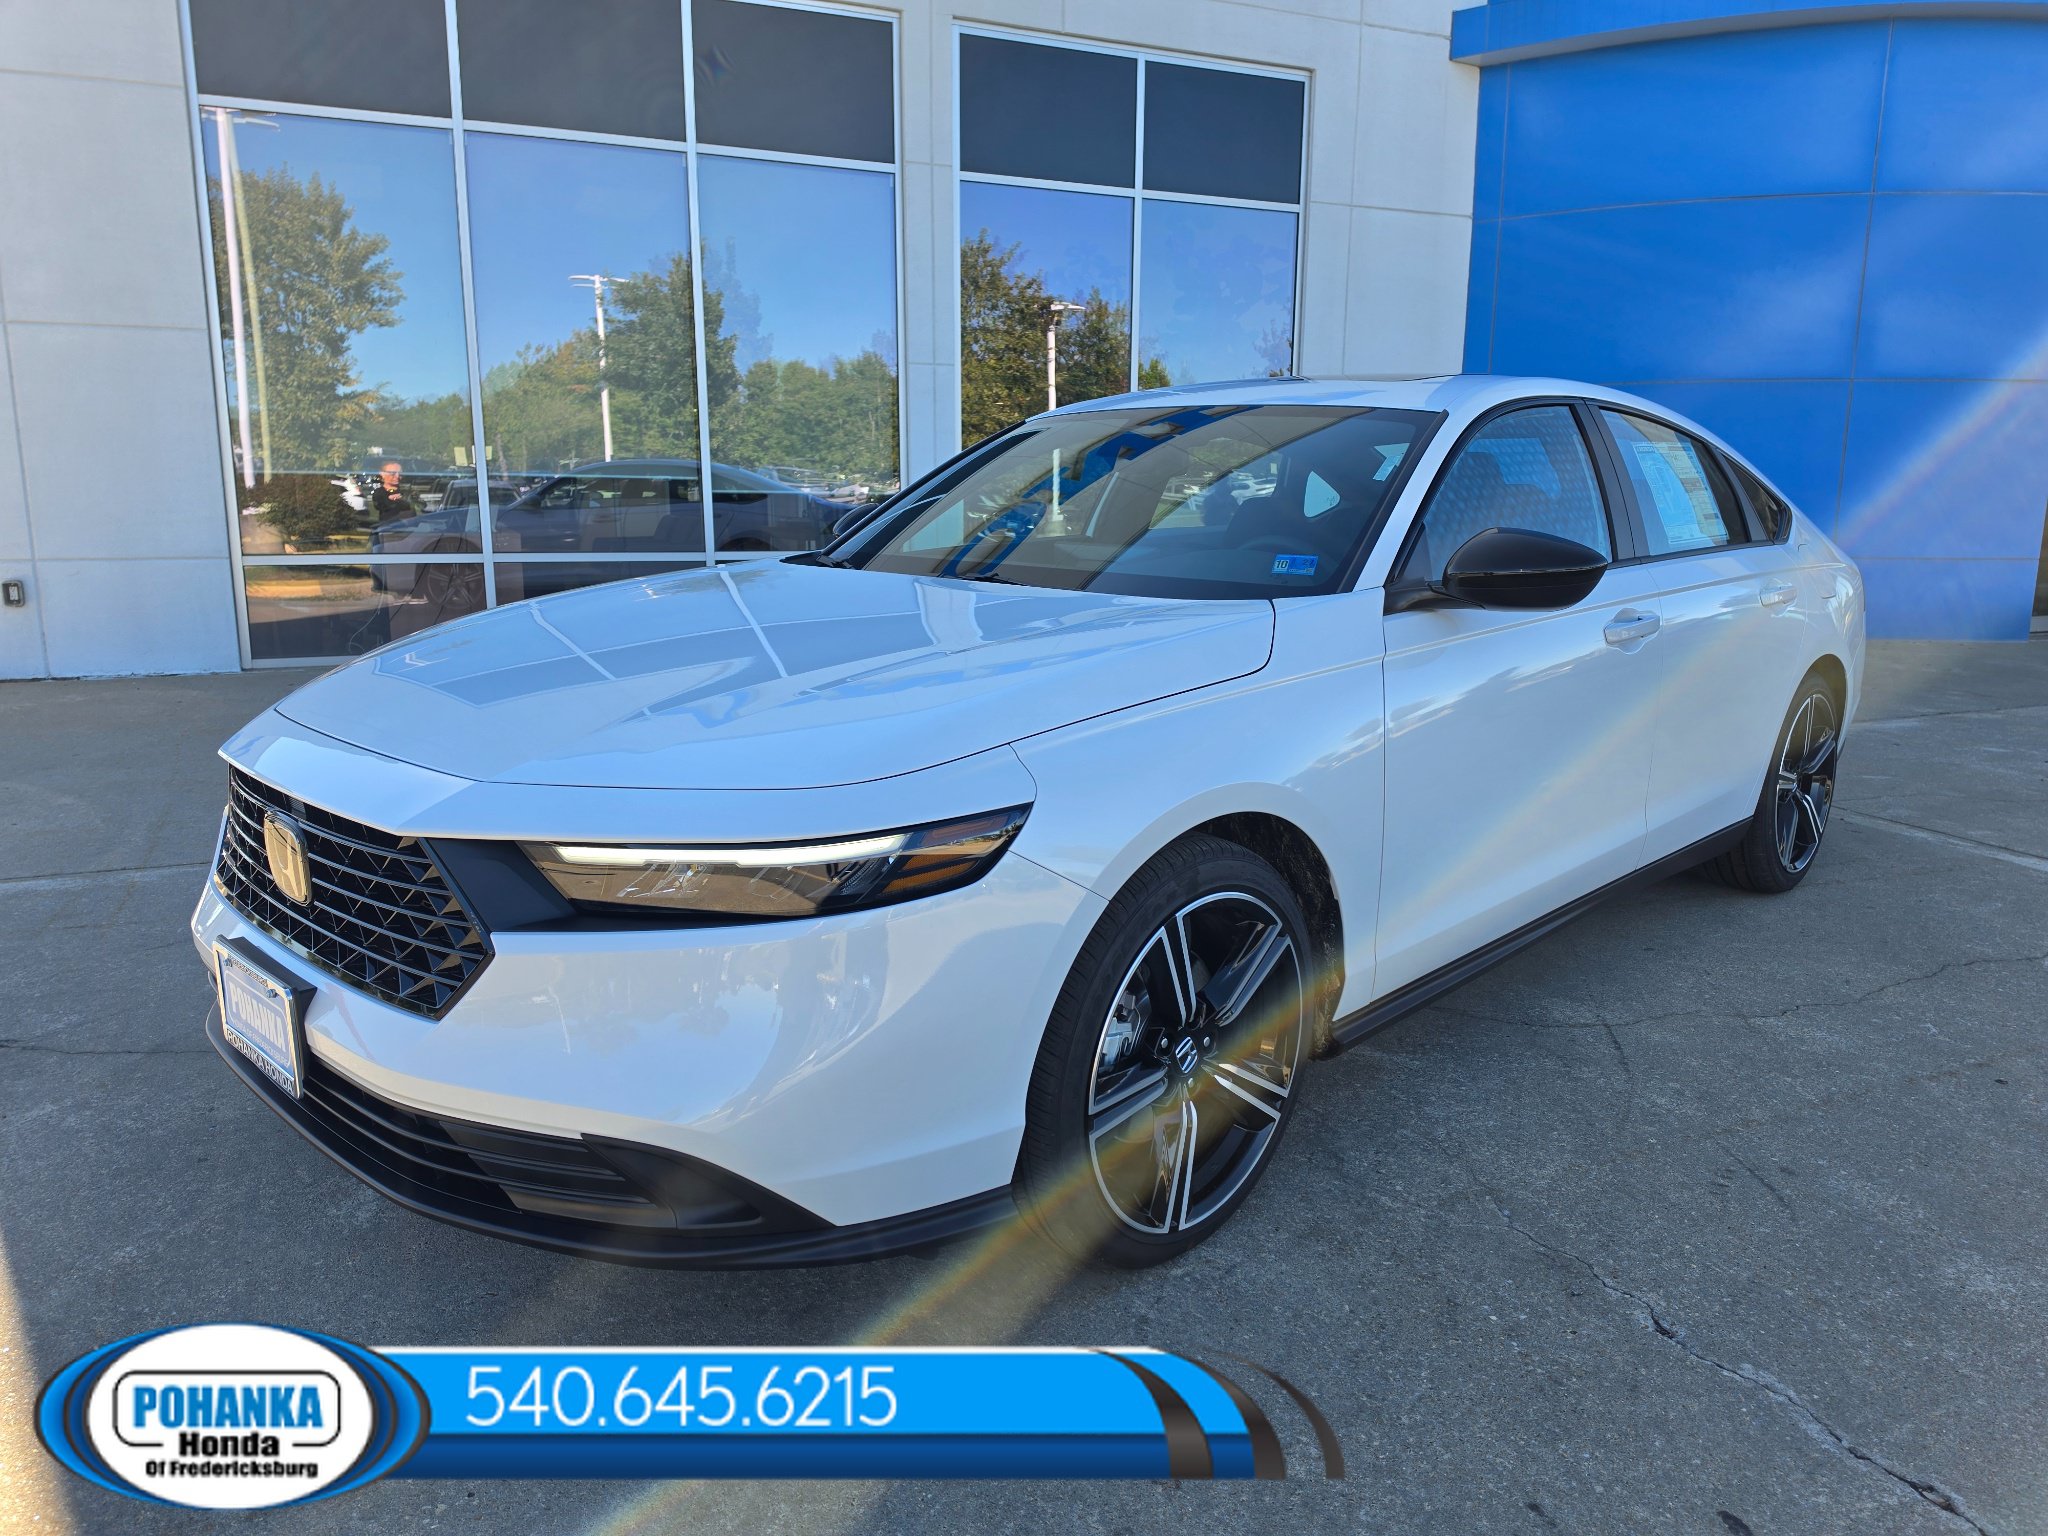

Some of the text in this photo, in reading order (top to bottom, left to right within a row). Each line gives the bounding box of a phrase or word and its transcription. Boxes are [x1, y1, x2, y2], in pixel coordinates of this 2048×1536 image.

[1276, 560, 1289, 569] 10
[229, 982, 287, 1052] POHANKA
[227, 1028, 294, 1094] POHANKA HONDA
